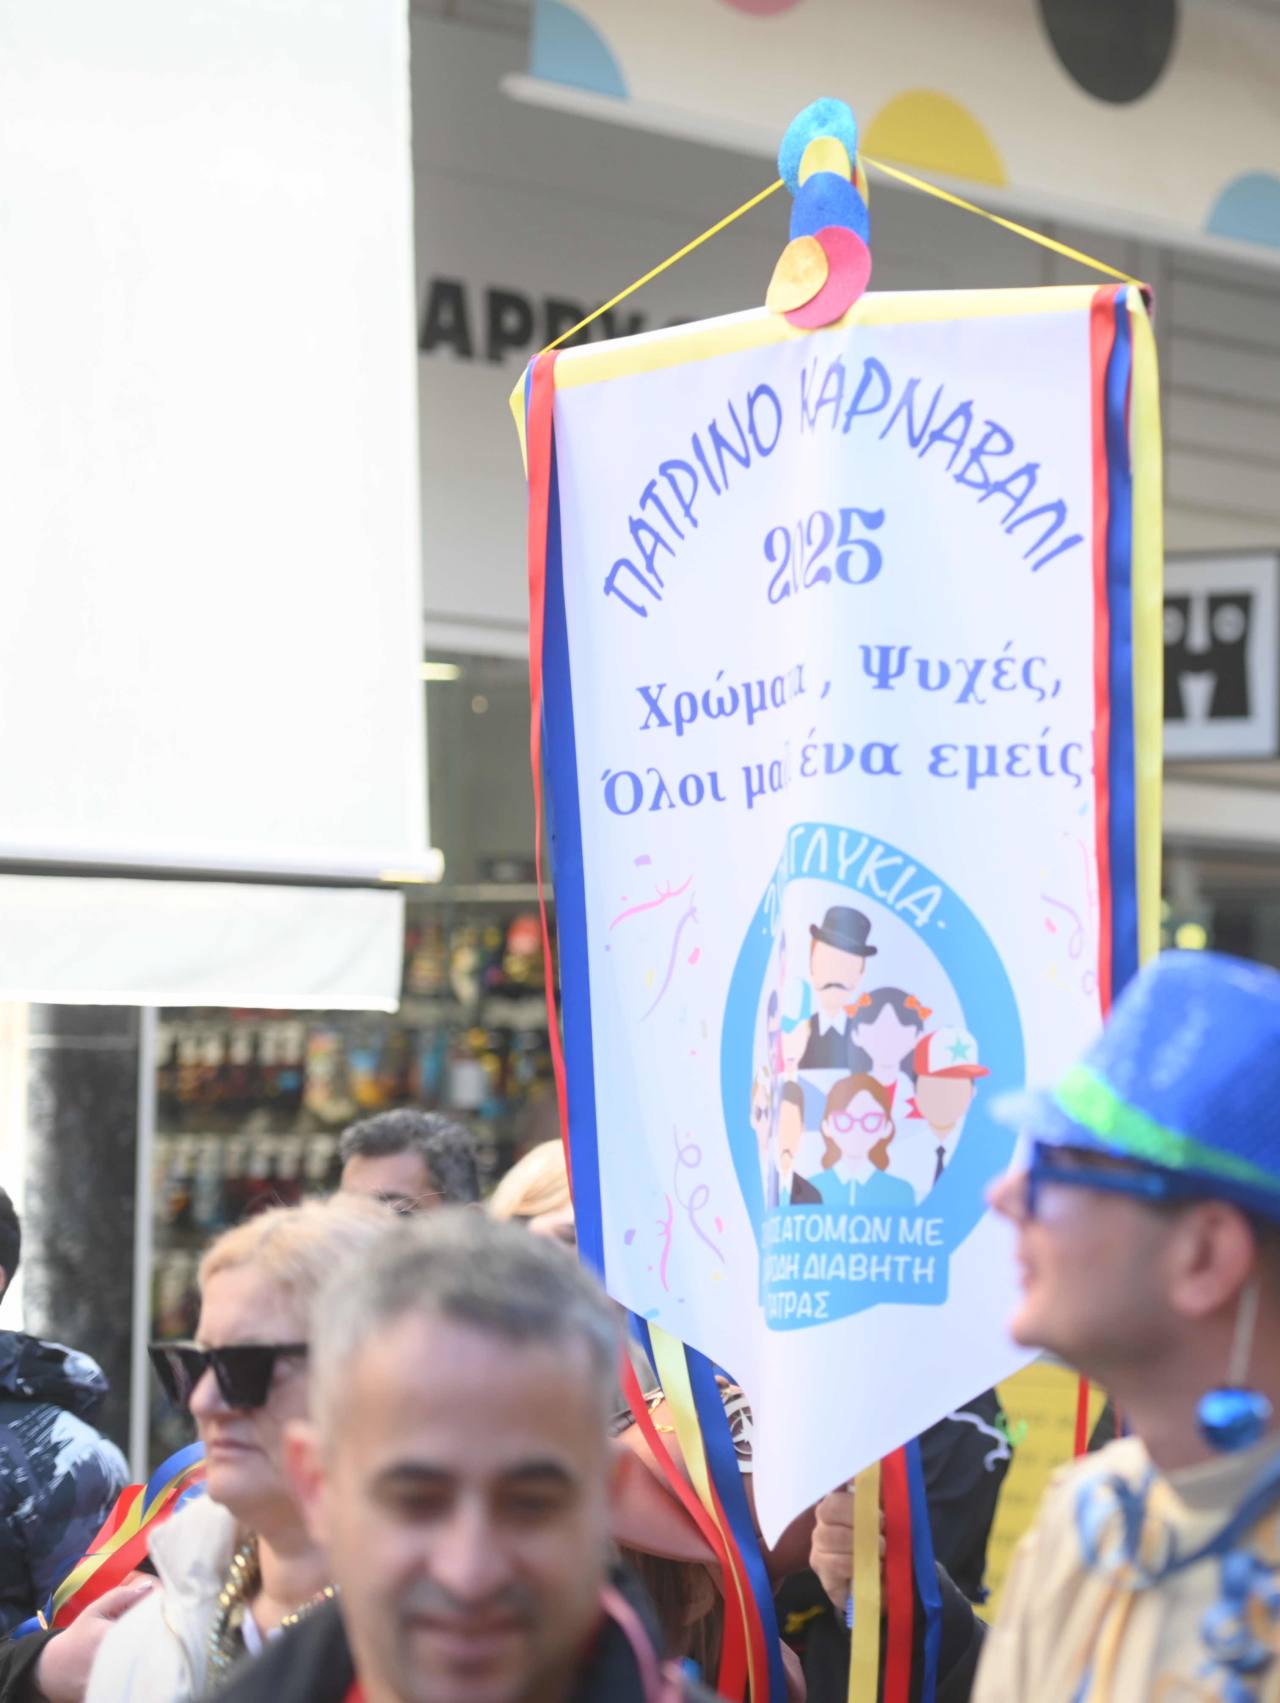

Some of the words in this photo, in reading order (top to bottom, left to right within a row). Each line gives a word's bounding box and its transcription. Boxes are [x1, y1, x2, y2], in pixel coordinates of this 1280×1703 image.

[603, 382, 783, 618] ΠΑΤΡΙΝΟ
[858, 639, 1062, 704] Ψυχές,
[600, 768, 727, 816] Όλοι
[799, 726, 902, 775] ένα
[928, 725, 1094, 790] εμείς
[899, 1216, 945, 1247] ΜΕ
[803, 1252, 936, 1285] ΔΙΑΒΗΤΗ
